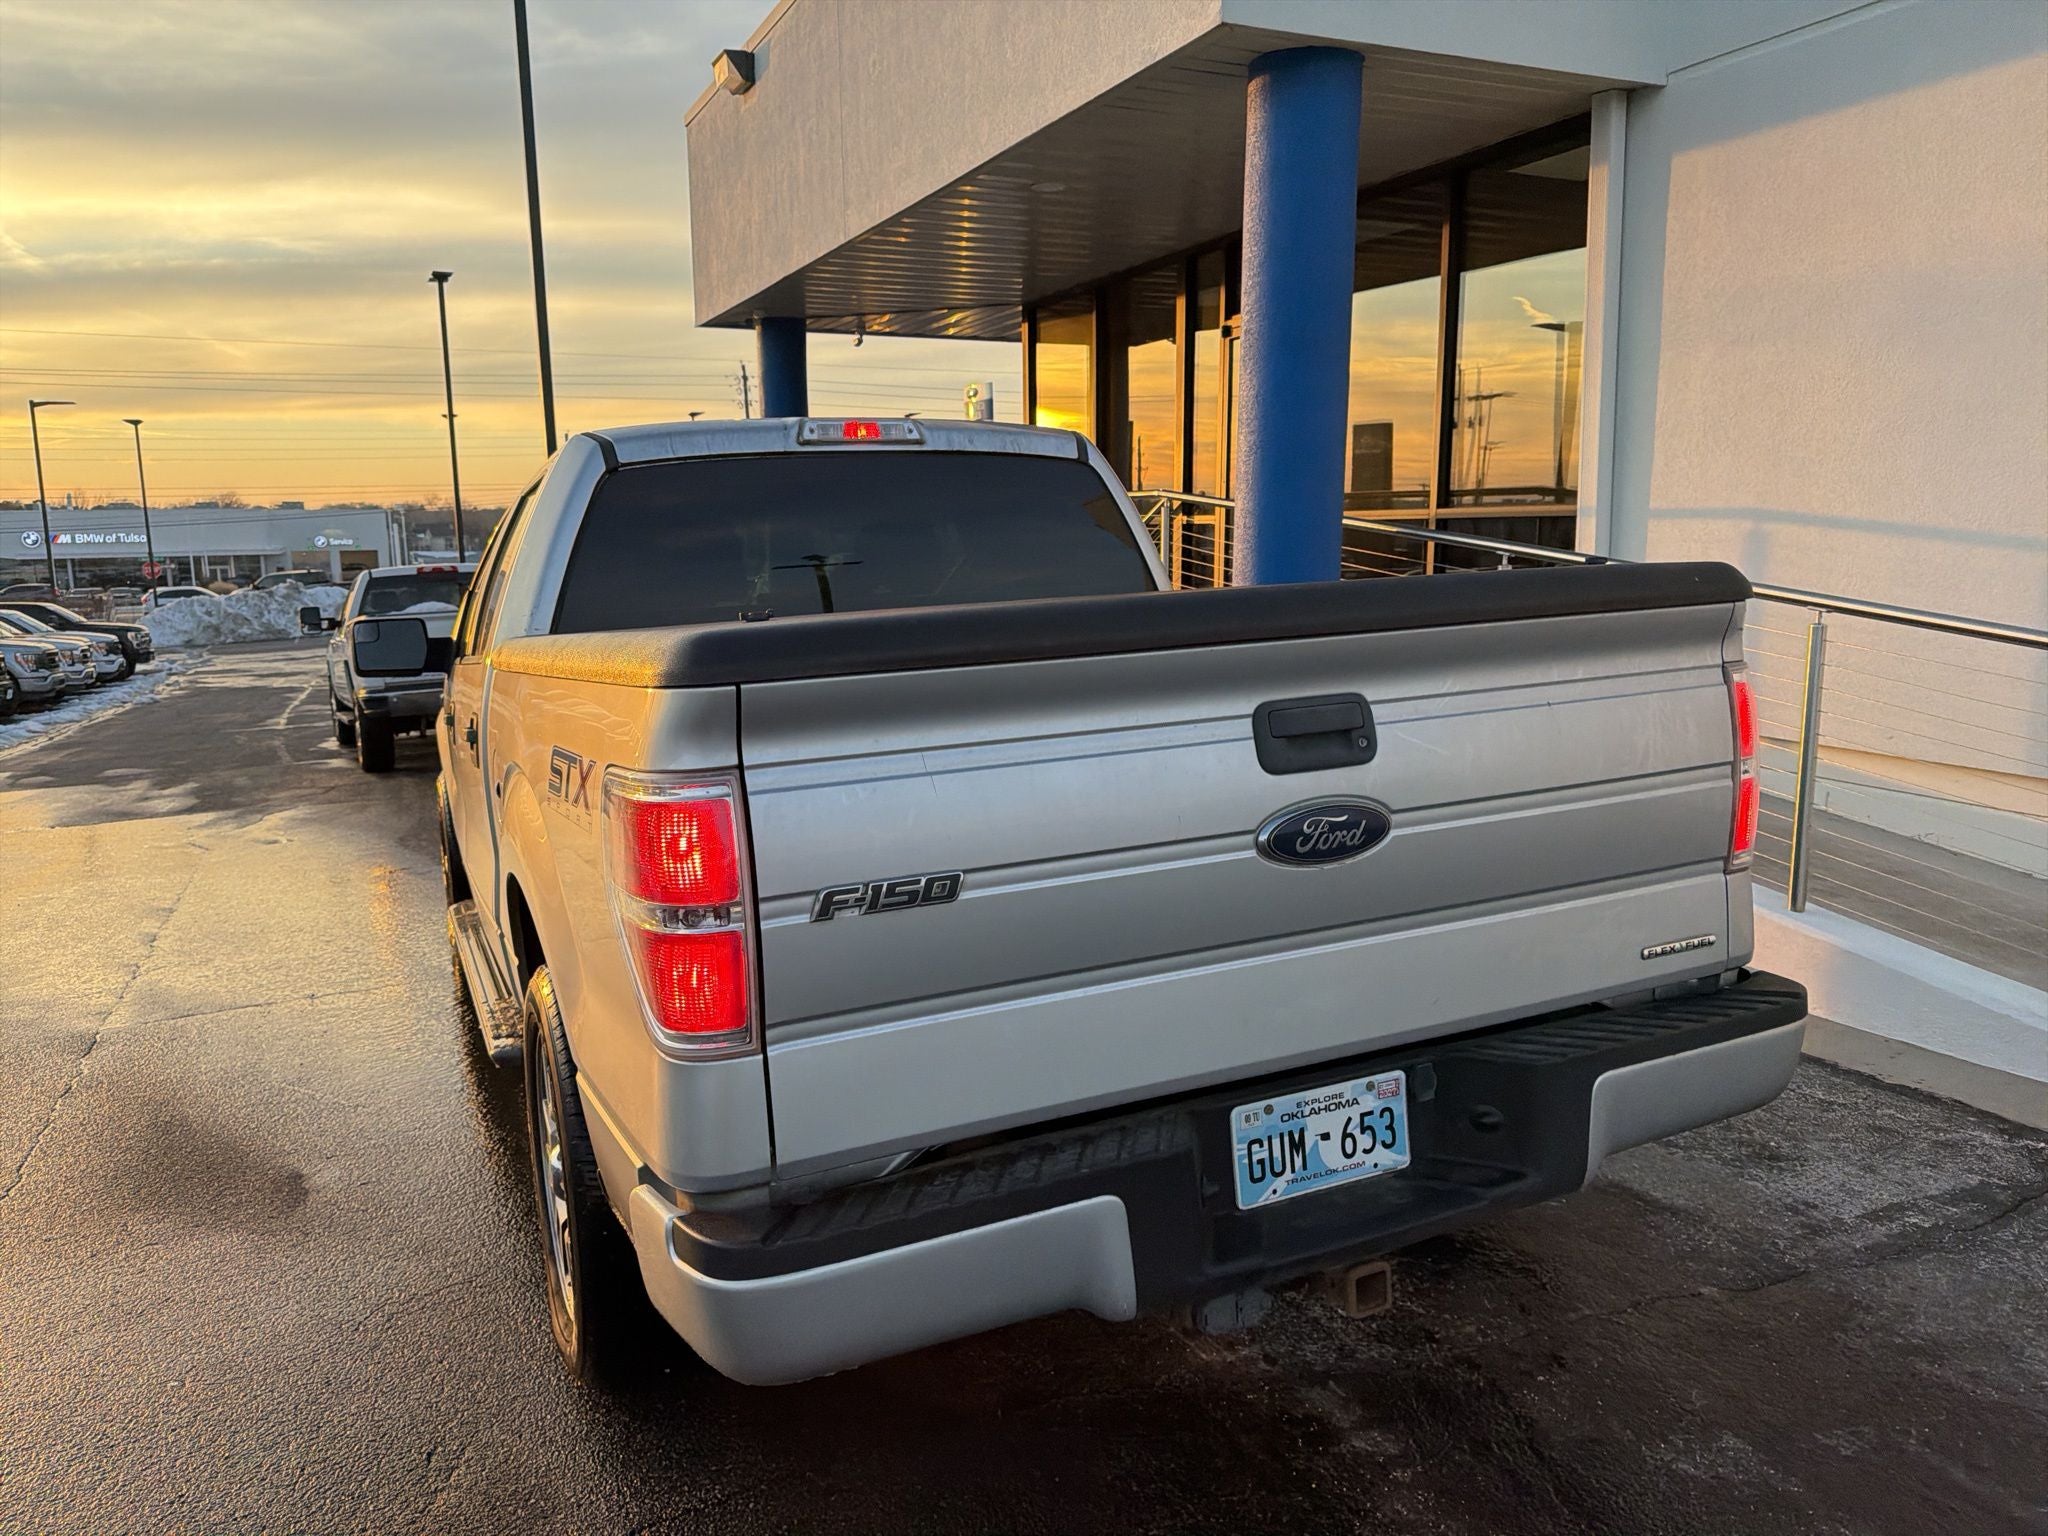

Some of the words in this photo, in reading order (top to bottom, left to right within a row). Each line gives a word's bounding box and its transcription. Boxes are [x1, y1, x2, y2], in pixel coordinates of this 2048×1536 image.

[75, 533, 104, 544] BMW
[105, 533, 117, 543] of
[117, 532, 147, 543] Tulsa
[547, 745, 597, 816] STX
[1296, 814, 1367, 854] Ford
[809, 870, 964, 923] F-150
[1646, 944, 1677, 958] FLEX
[1684, 937, 1715, 950] FUEL
[1280, 1097, 1361, 1124] OKLAHOMA
[1295, 1091, 1345, 1109] EXPLORE
[1246, 1126, 1308, 1184] GUM
[1340, 1106, 1397, 1160] 653
[1285, 1160, 1366, 1187] TRAVELOK.COM
